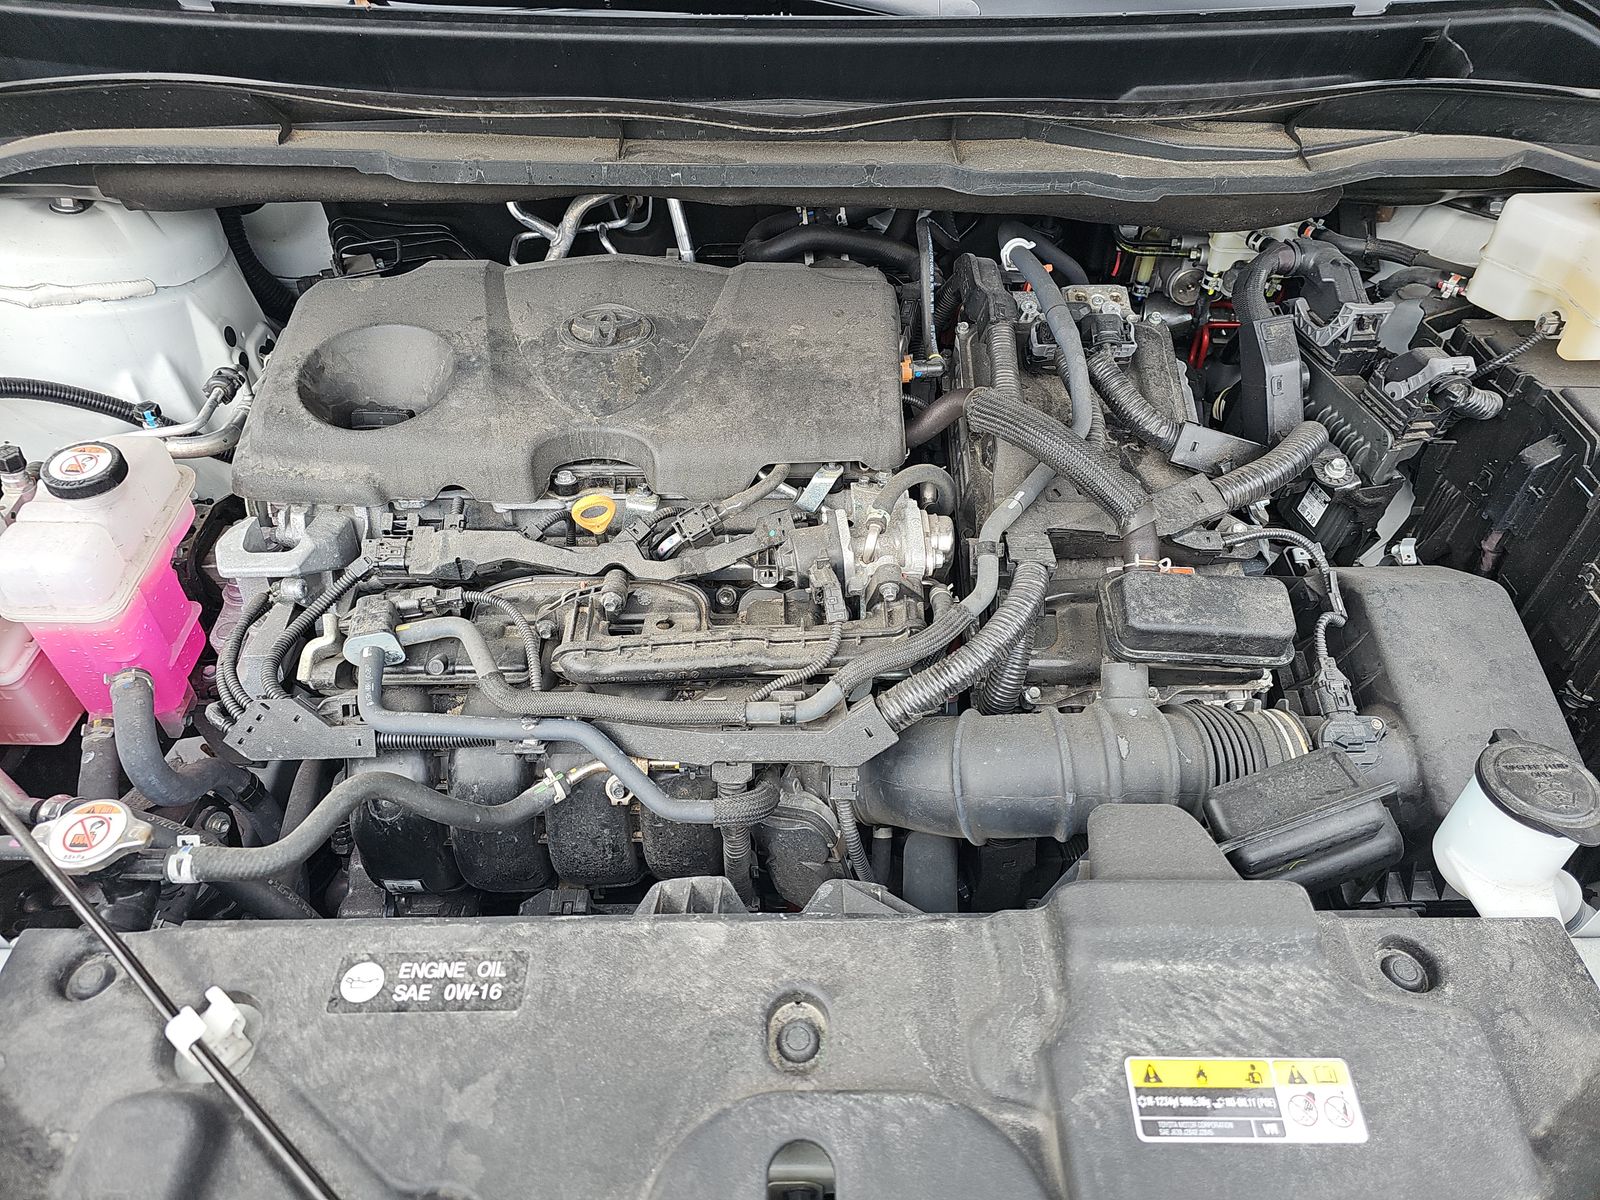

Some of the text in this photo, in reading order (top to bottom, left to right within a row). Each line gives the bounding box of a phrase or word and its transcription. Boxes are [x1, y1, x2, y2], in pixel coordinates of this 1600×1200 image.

[398, 960, 507, 979] ENGINE OIL
[392, 982, 503, 1002] SAE 0W-16
